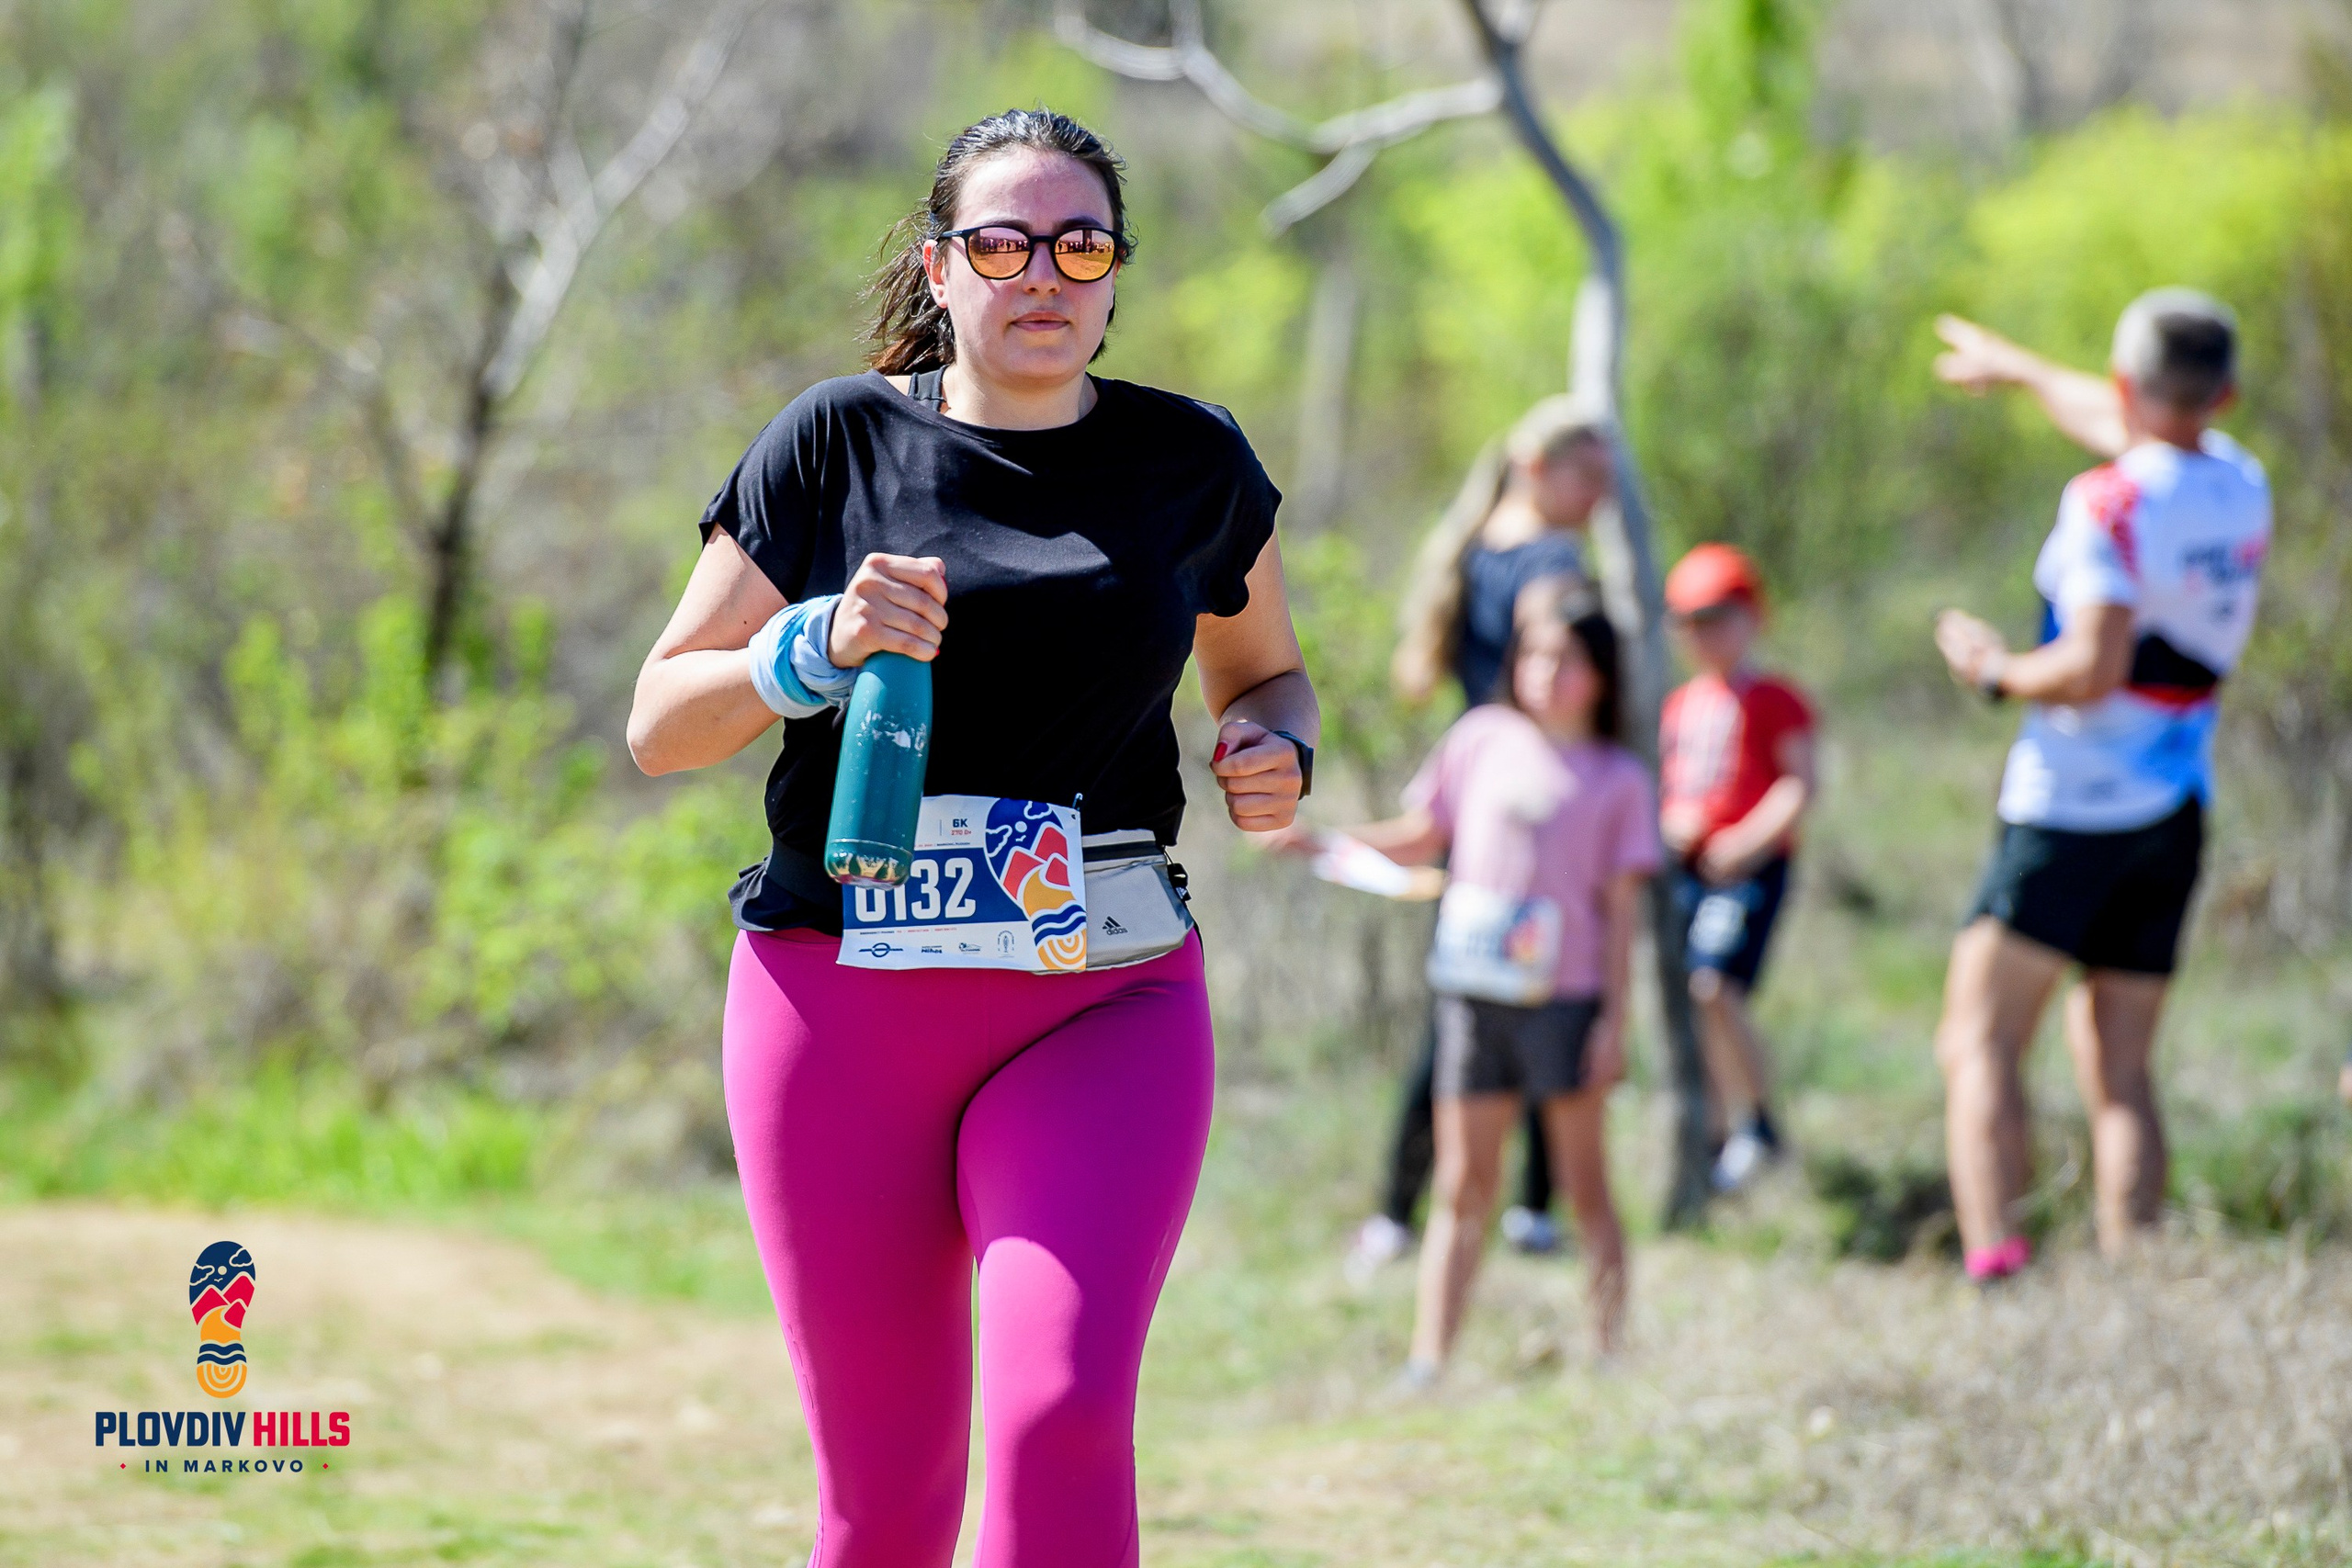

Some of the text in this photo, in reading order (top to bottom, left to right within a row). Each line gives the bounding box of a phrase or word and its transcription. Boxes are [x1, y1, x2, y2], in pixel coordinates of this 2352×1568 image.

[953, 818, 968, 828] 6K
[854, 857, 977, 923] 0132
[1106, 927, 1129, 936] adidas
